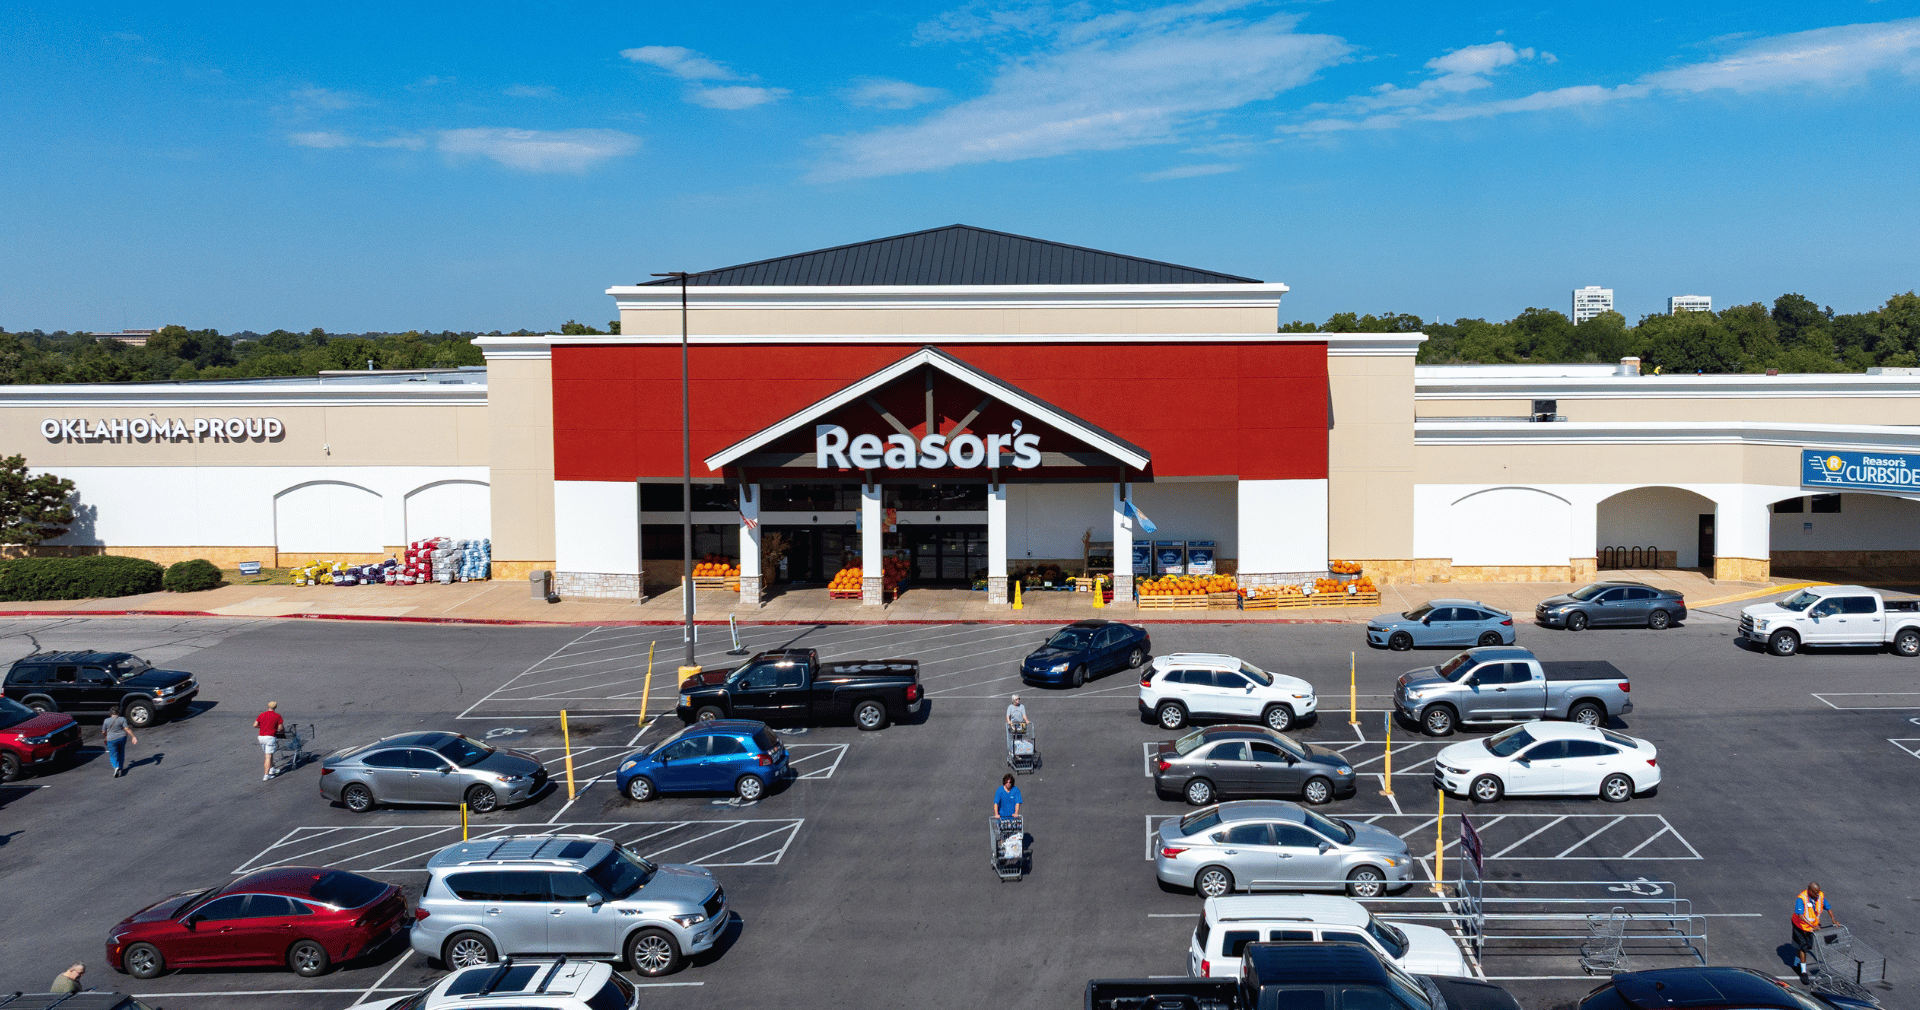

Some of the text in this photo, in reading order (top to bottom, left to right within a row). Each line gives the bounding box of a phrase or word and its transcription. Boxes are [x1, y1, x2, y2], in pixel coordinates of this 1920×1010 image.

[40, 417, 283, 438] OKLAHOMA PROUD
[816, 419, 1042, 469] Reasor's
[1862, 456, 1906, 467] Reasor's
[1846, 465, 1920, 485] CURBSIDE
